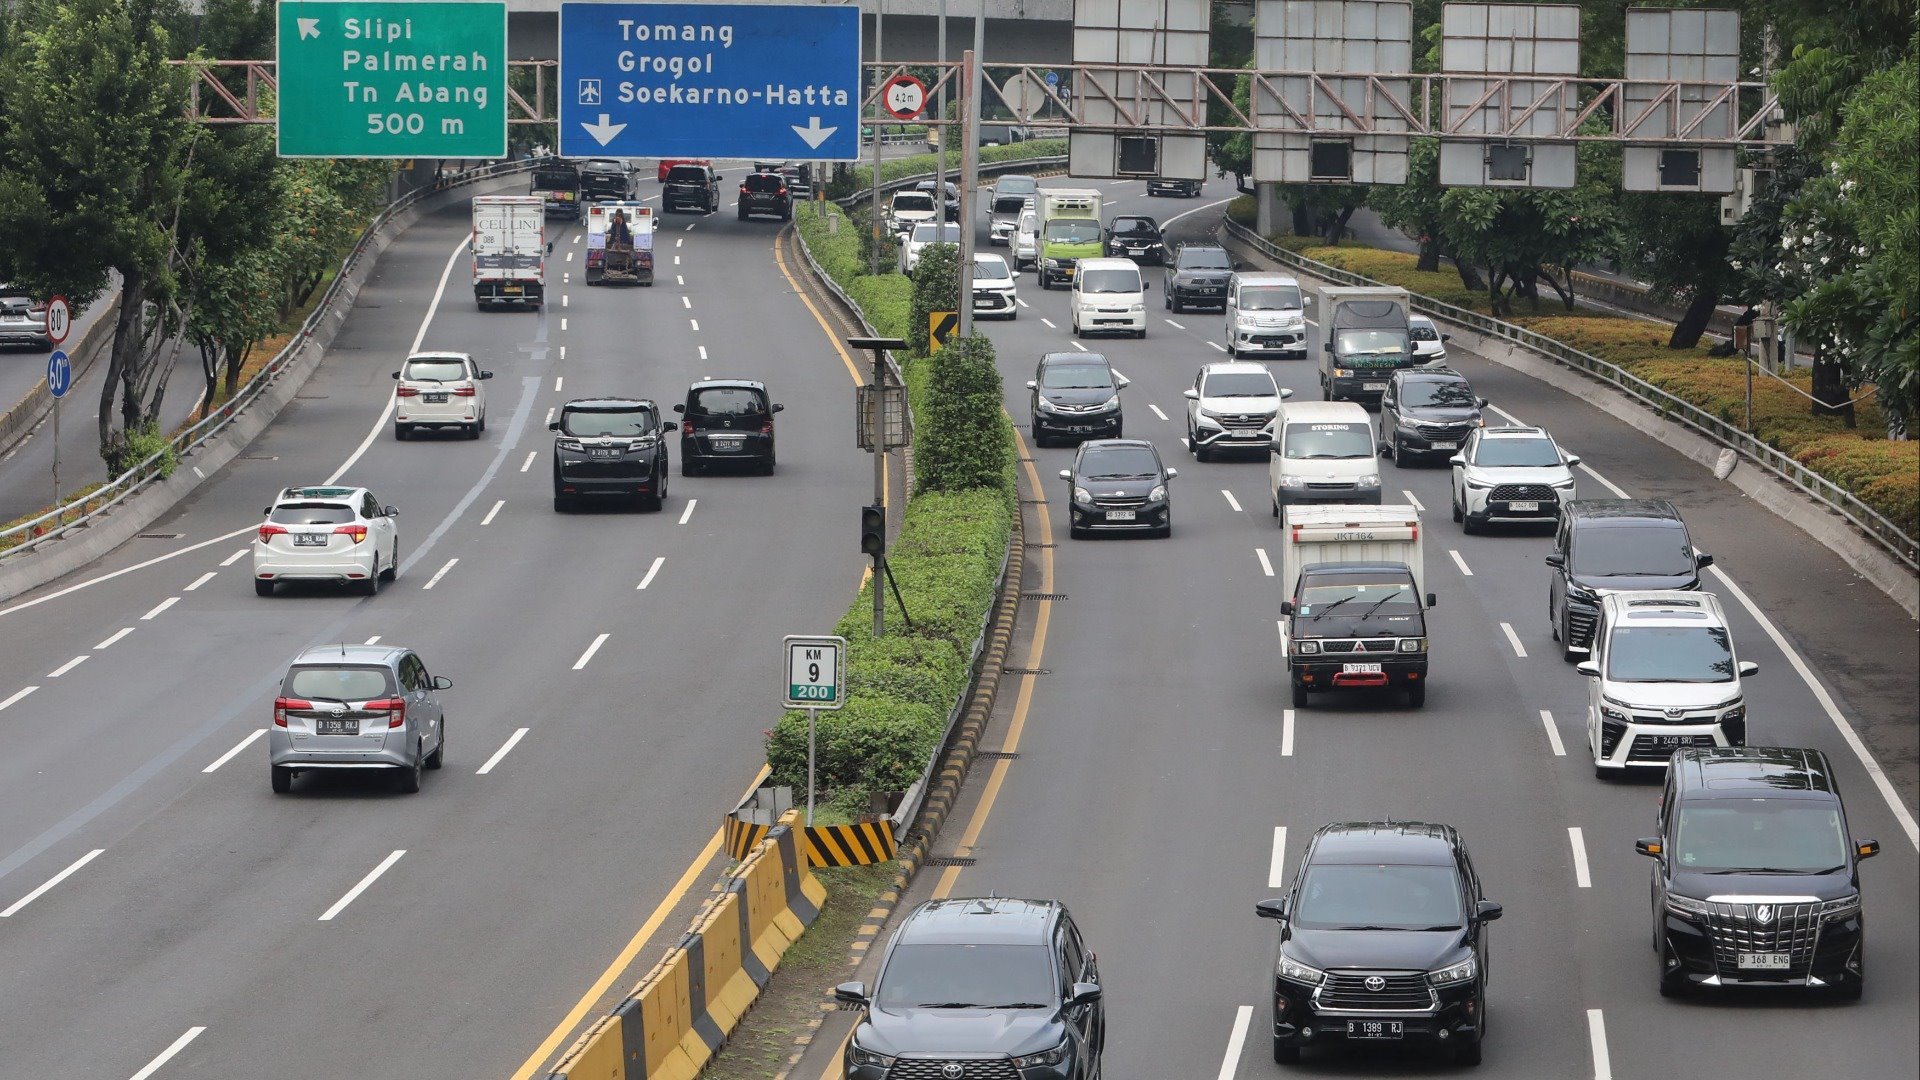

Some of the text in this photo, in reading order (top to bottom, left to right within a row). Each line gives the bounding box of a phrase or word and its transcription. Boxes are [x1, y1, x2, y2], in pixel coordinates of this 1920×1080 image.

[344, 18, 412, 44] Slipi
[618, 19, 733, 49] Tomang
[343, 50, 488, 71] Palmerah
[618, 50, 712, 80] Grogol
[343, 81, 488, 110] Tn Abang
[617, 81, 849, 106] Soekarno-Hatta
[367, 112, 464, 135] 500 m
[50, 308, 62, 332] 80
[50, 358, 62, 391] 60
[1334, 532, 1374, 541] JKT 164
[806, 649, 822, 660] KM
[808, 663, 820, 683] 9
[1344, 664, 1349, 672] B
[798, 685, 828, 699] 200
[318, 720, 323, 729] B
[345, 721, 358, 729] RKJ
[1653, 736, 1658, 745] B
[1739, 955, 1789, 965] B 168 ENG
[1348, 1022, 1401, 1033] B 1389 RJ
